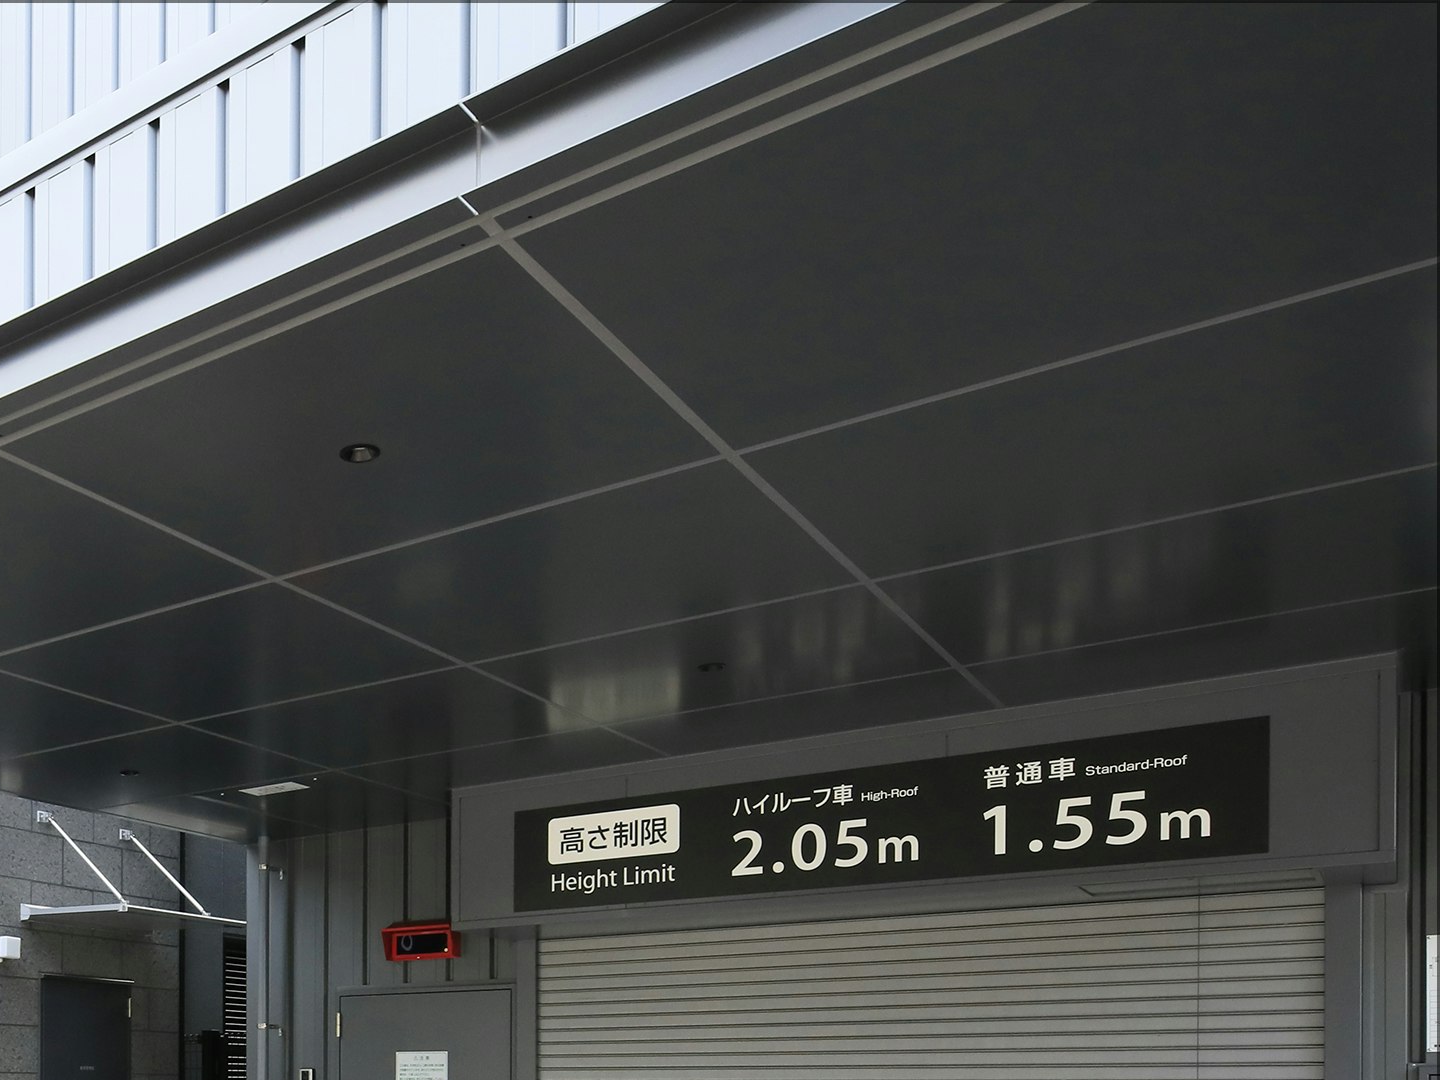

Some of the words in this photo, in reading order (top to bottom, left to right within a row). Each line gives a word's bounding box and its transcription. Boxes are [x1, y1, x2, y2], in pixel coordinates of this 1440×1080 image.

[983, 757, 1076, 790] 普通車
[1085, 755, 1188, 776] Standard-Roof
[732, 784, 854, 817] ハイルーフ車
[861, 786, 919, 802] High-Roof
[560, 817, 667, 855] 高さ制限
[731, 818, 920, 877] 2.05m
[551, 868, 617, 894] Height
[623, 863, 676, 886] Limit
